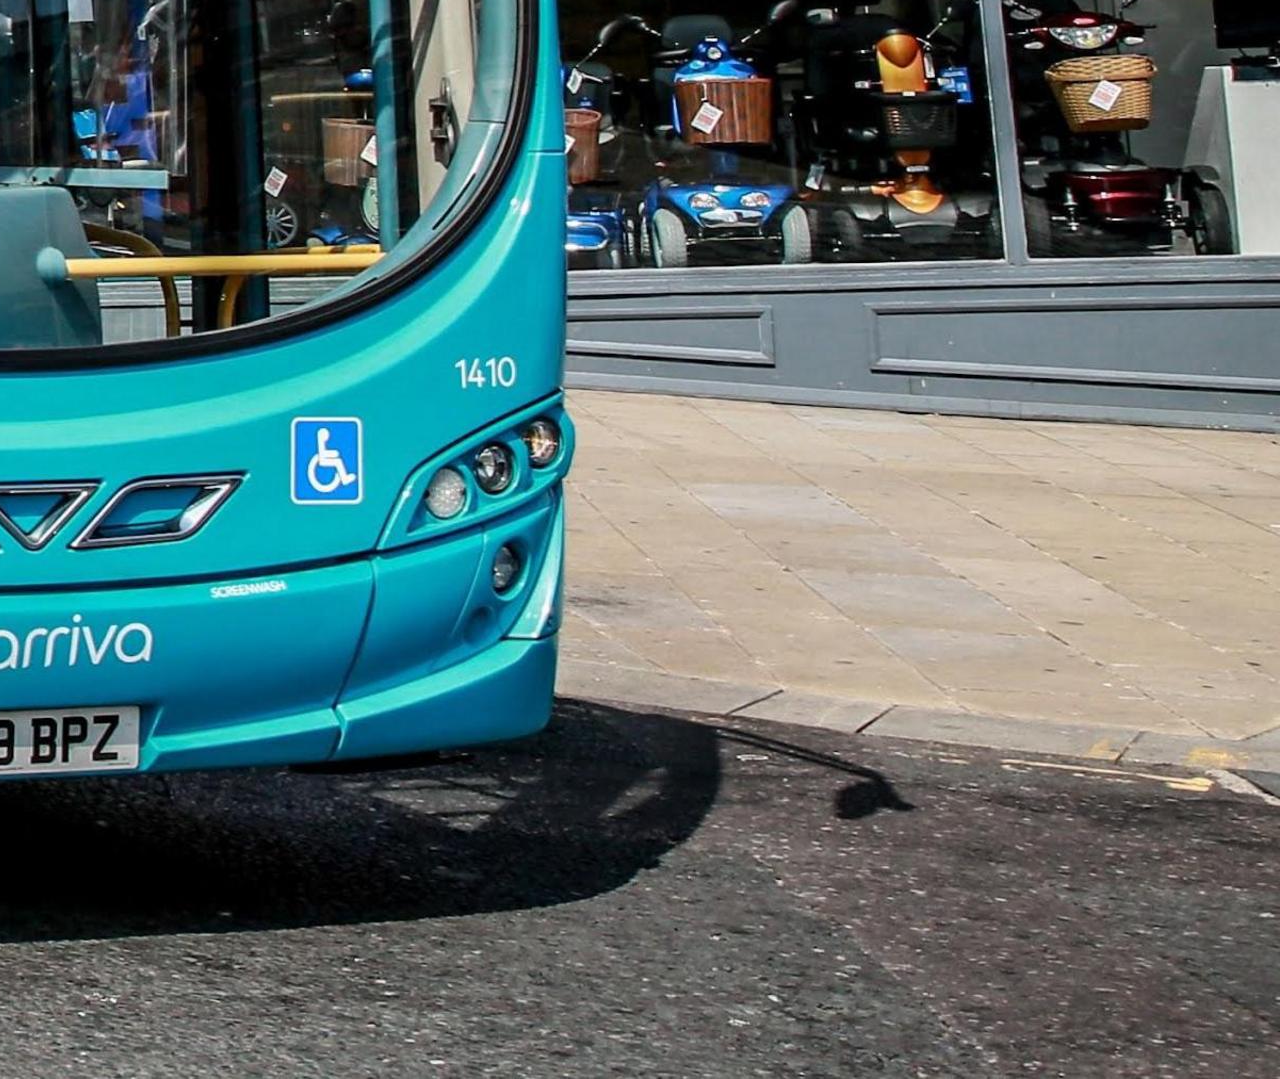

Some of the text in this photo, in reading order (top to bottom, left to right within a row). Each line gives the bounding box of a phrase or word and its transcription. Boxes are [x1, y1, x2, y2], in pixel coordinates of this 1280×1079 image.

[454, 356, 516, 389] 1410
[210, 580, 288, 599] SCREENWASH
[30, 714, 121, 766] BPZ
